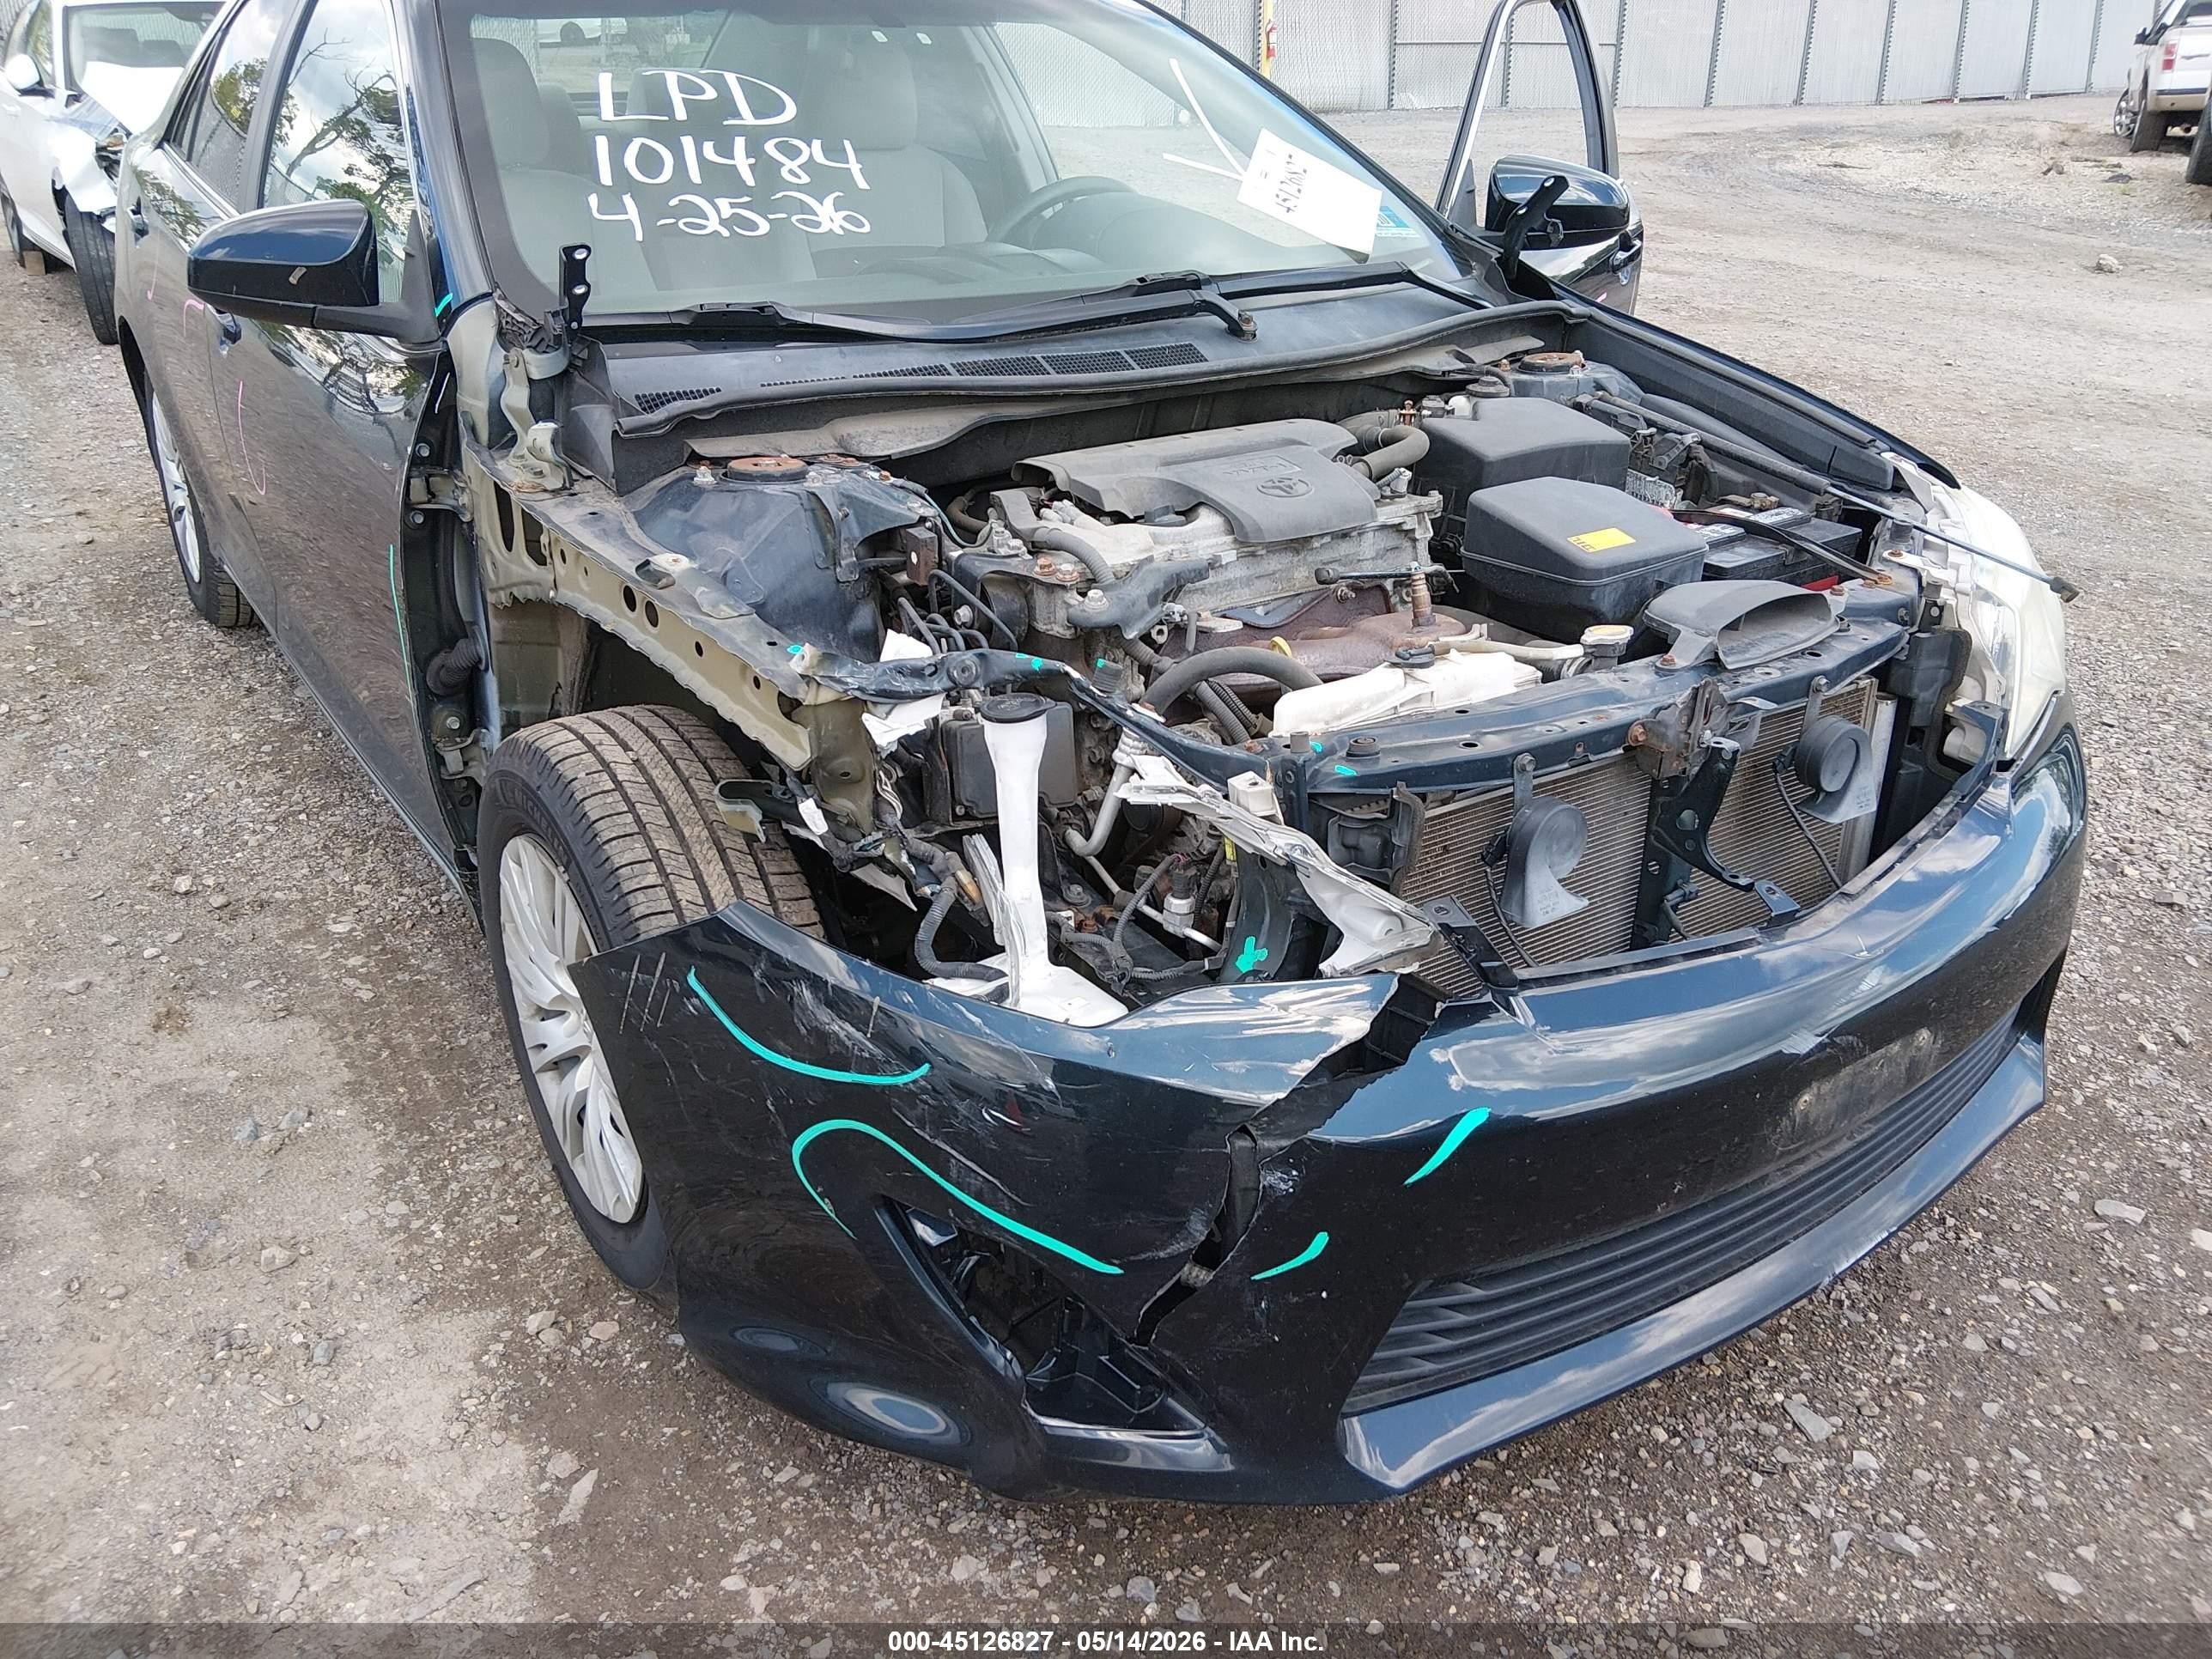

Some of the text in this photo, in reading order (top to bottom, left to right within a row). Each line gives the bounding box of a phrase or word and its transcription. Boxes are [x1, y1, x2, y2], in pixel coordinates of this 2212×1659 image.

[598, 70, 797, 125] LPD
[595, 135, 871, 190] 101484
[587, 191, 871, 241] 4-25-26
